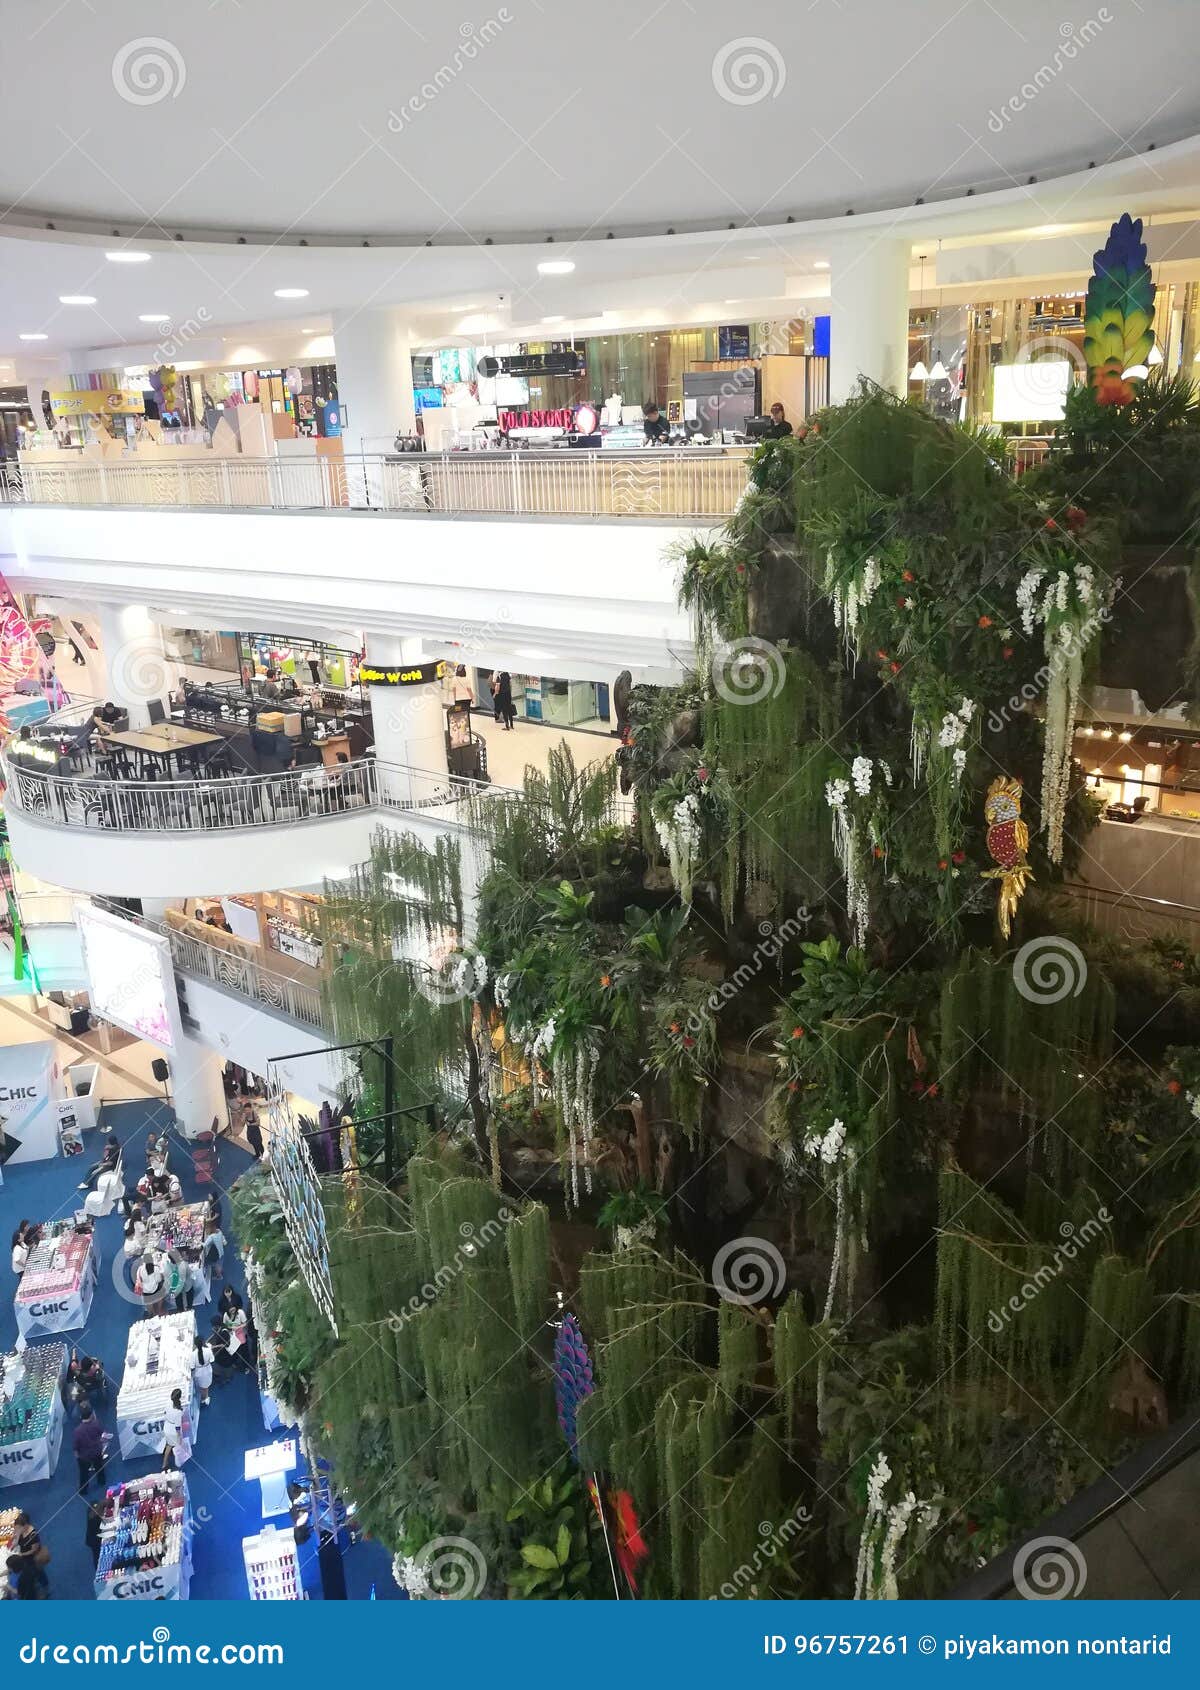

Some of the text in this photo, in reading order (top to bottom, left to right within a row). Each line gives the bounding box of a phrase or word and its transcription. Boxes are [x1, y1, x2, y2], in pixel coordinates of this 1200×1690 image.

[498, 408, 573, 433] COLD STONE
[29, 1301, 69, 1317] CHIC
[132, 1420, 165, 1435] CHI
[112, 1576, 164, 1599] CHIC
